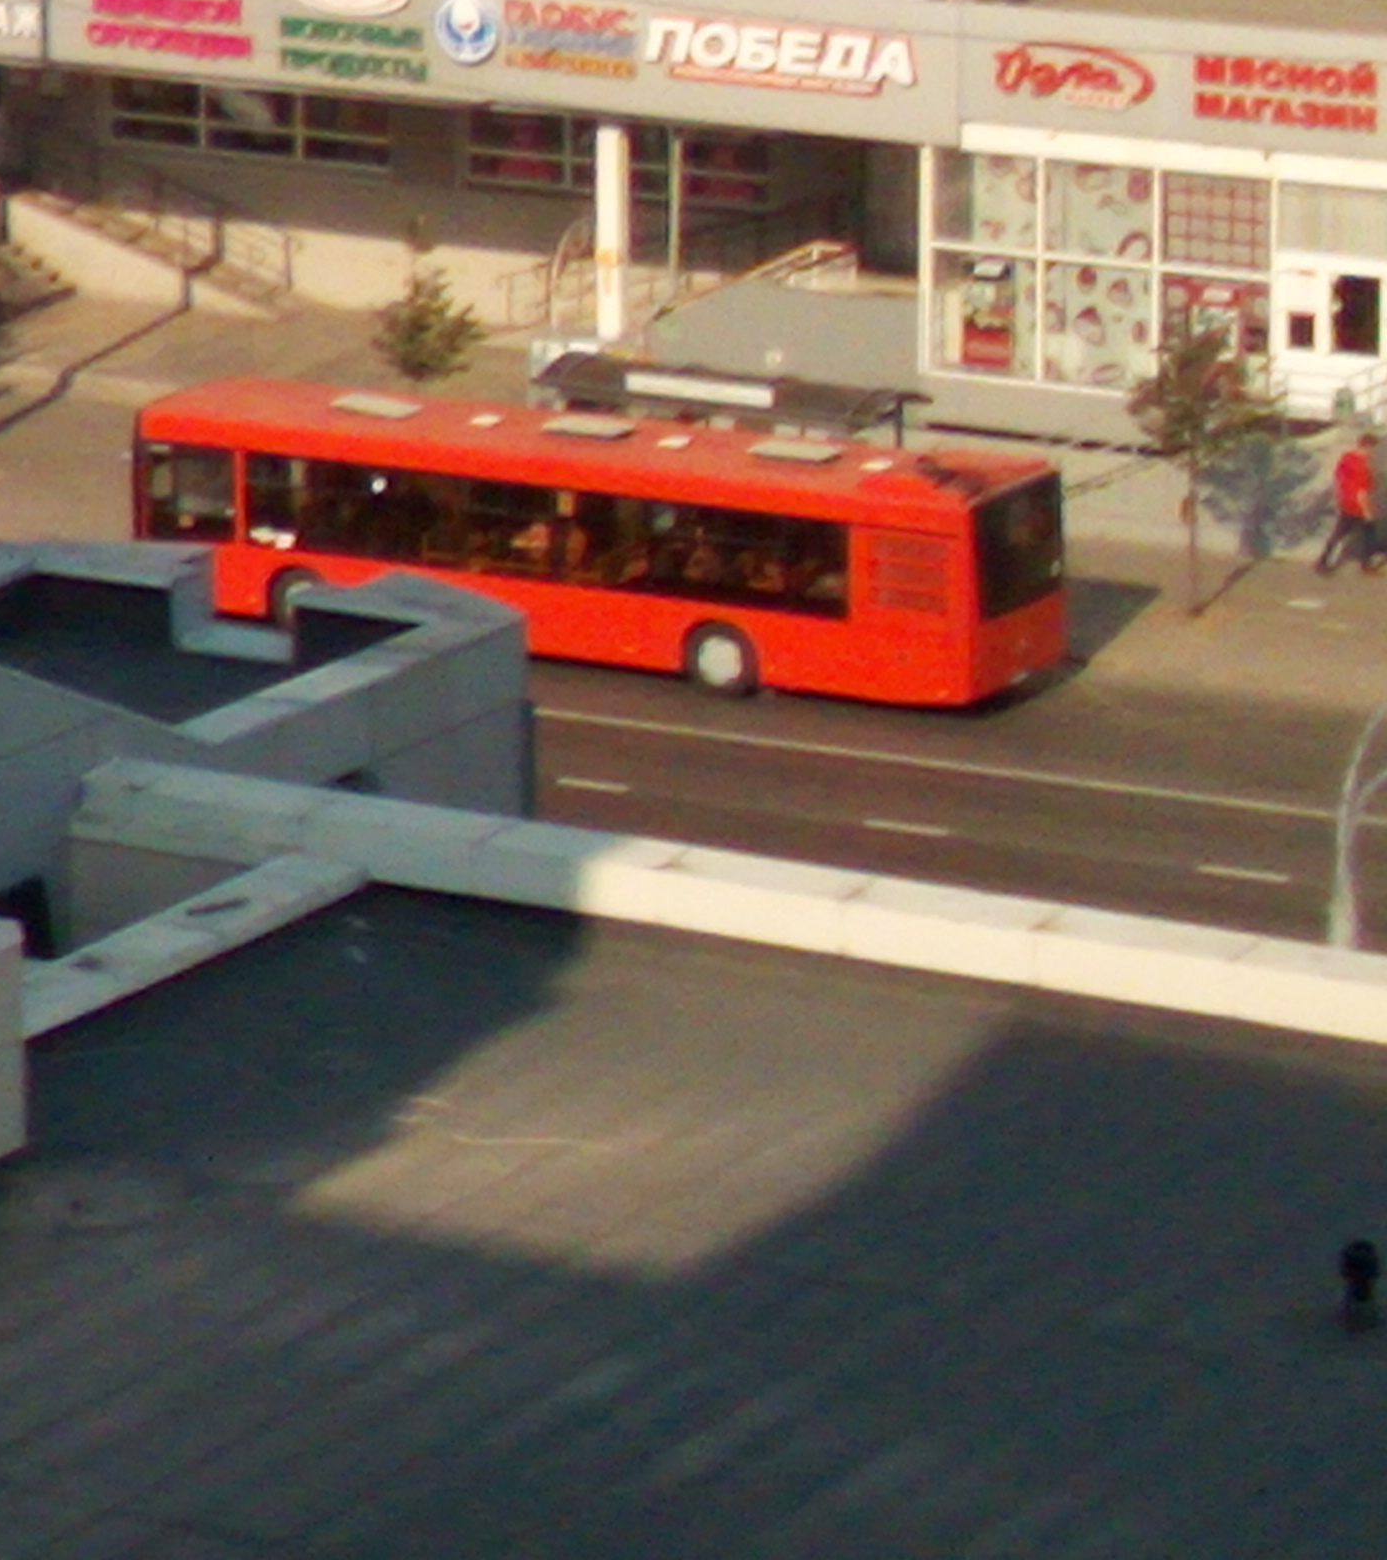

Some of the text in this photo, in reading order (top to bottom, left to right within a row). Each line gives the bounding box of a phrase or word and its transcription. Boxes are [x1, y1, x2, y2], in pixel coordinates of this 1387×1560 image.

[644, 14, 919, 88] ПОБЕДА
[1193, 52, 1378, 99] МЯСНОЙ
[1193, 90, 1378, 134] МАГАЗИН
